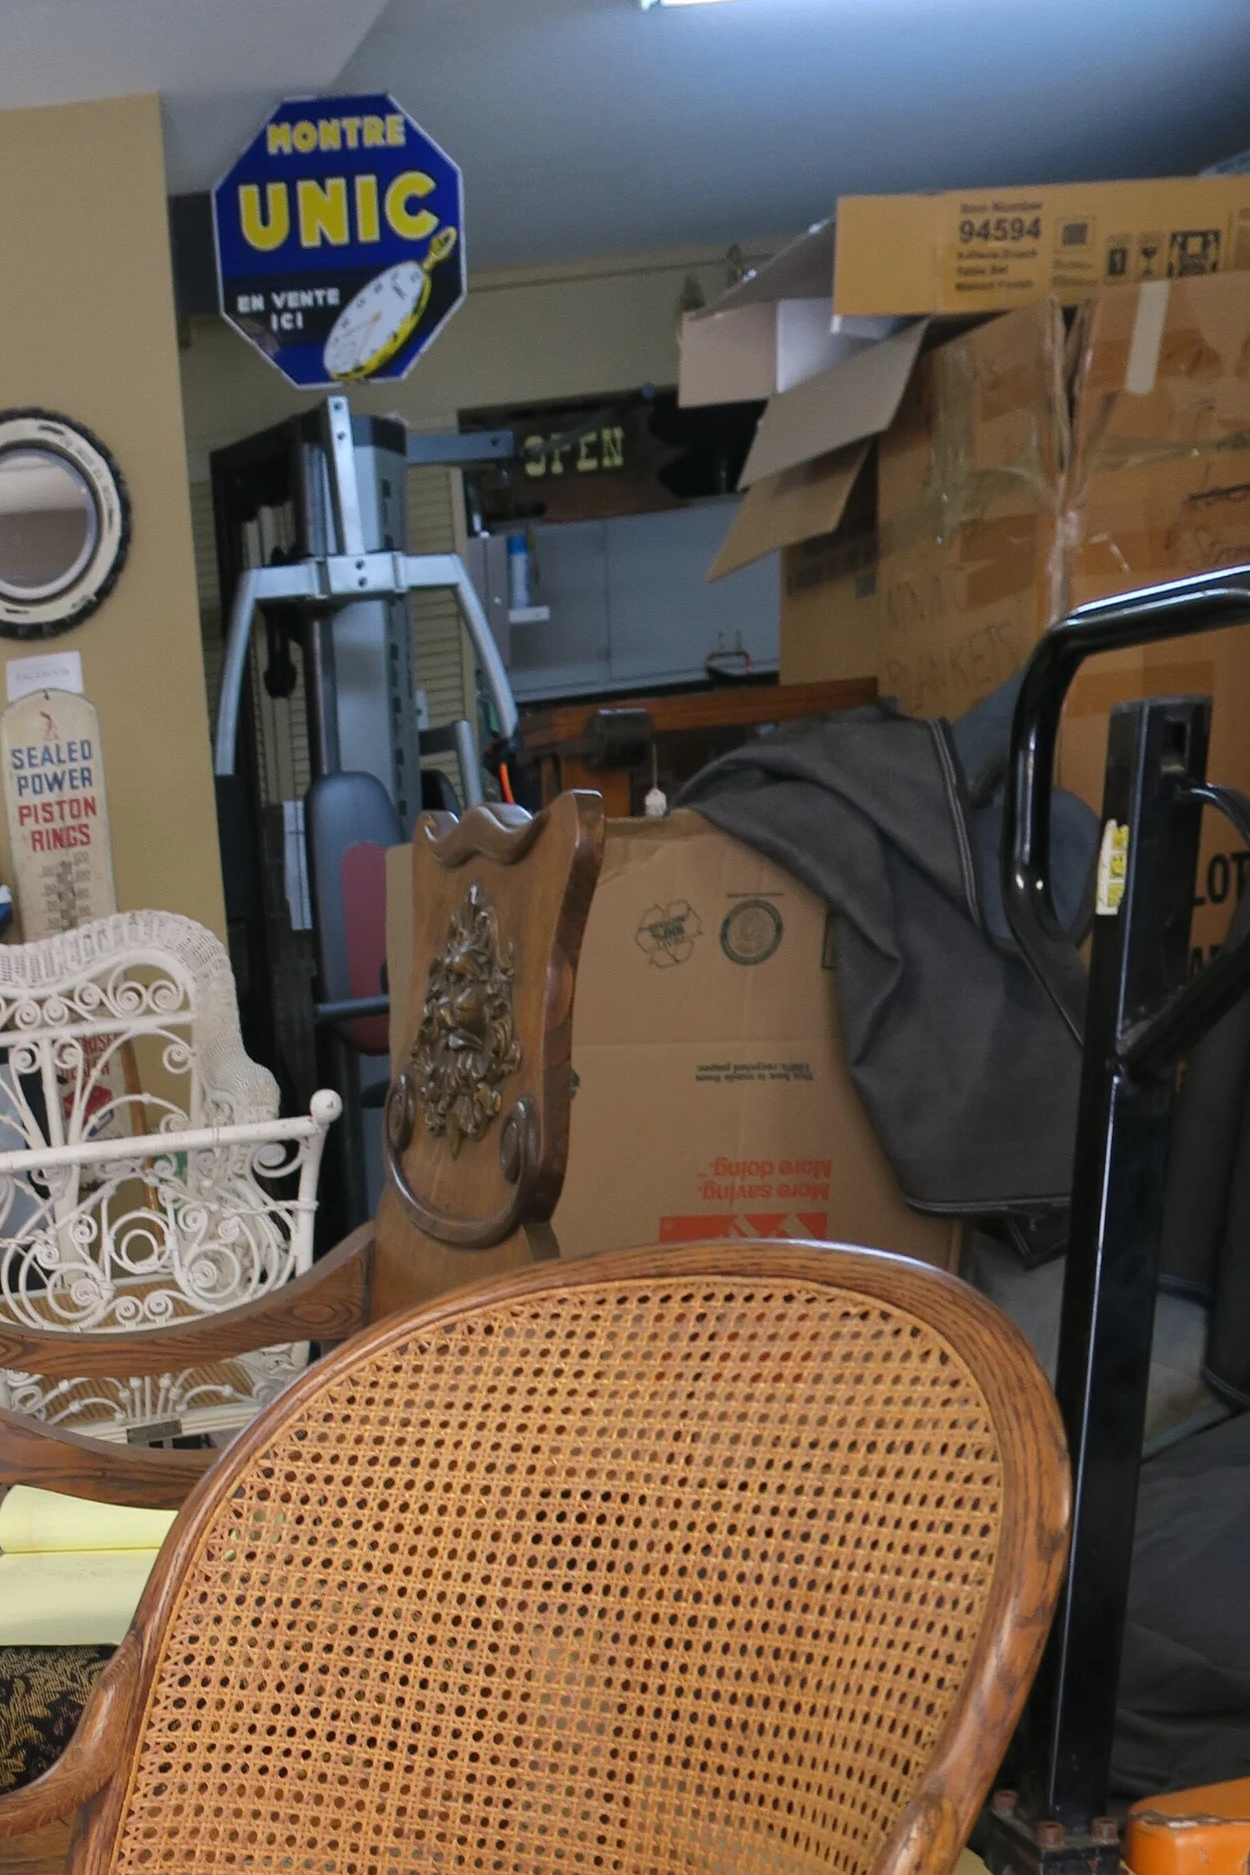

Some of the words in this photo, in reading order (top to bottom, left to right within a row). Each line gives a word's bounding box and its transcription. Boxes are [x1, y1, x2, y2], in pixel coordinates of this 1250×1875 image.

[266, 114, 406, 156] MONTRE
[237, 170, 439, 252] UNIC
[959, 216, 1042, 243] 94594
[236, 293, 265, 314] EN
[271, 287, 341, 310] VENTE
[270, 312, 304, 332] ICI
[11, 738, 93, 771] SEALED
[17, 767, 93, 797] POWER
[18, 796, 98, 827] PISTON
[30, 823, 92, 852] RINGS
[1192, 851, 1250, 906] OT
[778, 1159, 833, 1179] More
[698, 1180, 773, 1202] saving.
[778, 1183, 830, 1200] More
